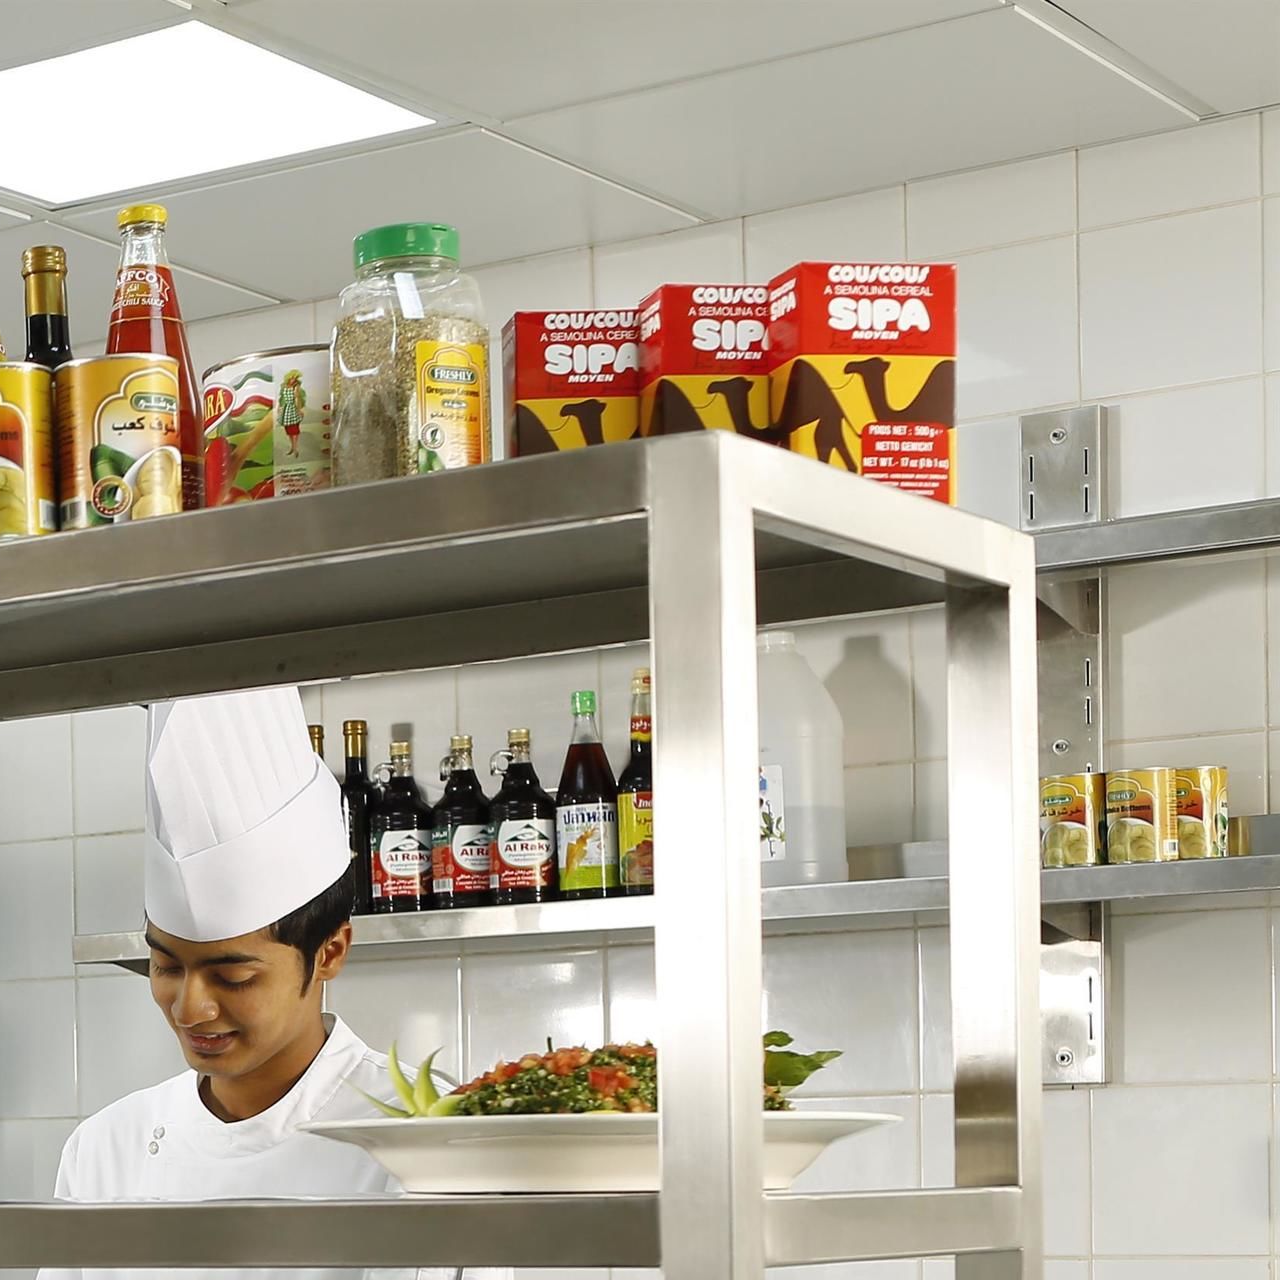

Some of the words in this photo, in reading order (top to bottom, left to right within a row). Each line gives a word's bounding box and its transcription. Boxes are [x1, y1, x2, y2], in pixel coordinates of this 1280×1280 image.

[828, 265, 930, 283] COUSCOUS
[692, 287, 768, 304] COUSCO
[824, 286, 832, 295] A
[834, 285, 889, 295] SEMOLINA
[891, 286, 933, 297] CEREAL
[688, 307, 696, 316] A
[698, 306, 753, 316] SEMOLINA
[827, 297, 931, 332] SIPA
[541, 333, 548, 342] A
[549, 330, 604, 342] SEMOLINA
[606, 330, 638, 341] CERE
[852, 331, 899, 340] MOYEN
[544, 343, 639, 376] SIPA
[715, 351, 762, 360] MOYEN
[434, 369, 473, 380] FRESHLY
[567, 374, 614, 383] MOYEN
[460, 848, 473, 857] Al
[504, 844, 517, 852] Al
[520, 843, 551, 854] Raky
[386, 854, 398, 862] Al
[402, 853, 431, 863] Raky
